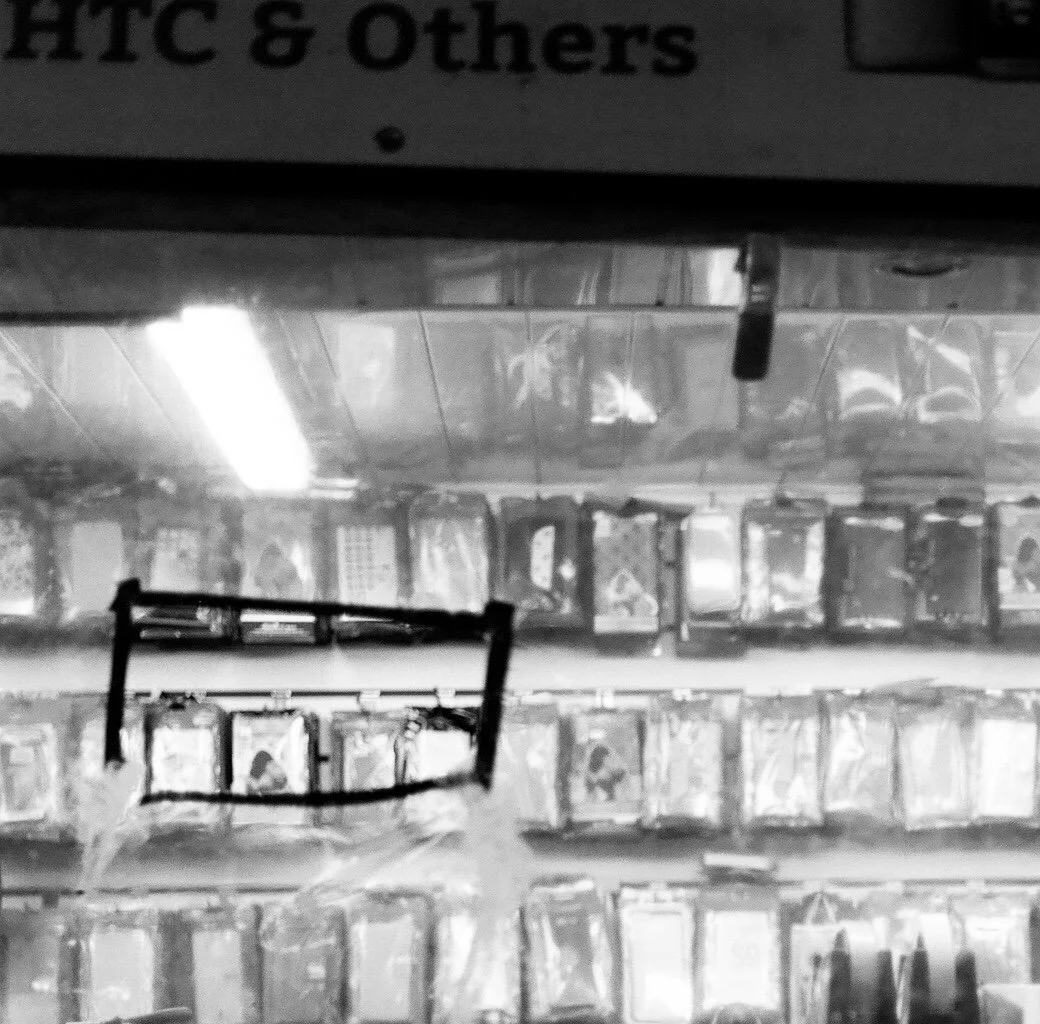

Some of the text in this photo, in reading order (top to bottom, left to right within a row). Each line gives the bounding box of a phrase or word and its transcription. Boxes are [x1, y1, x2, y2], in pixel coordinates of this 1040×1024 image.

[3, 0, 697, 76] HTC & Others
